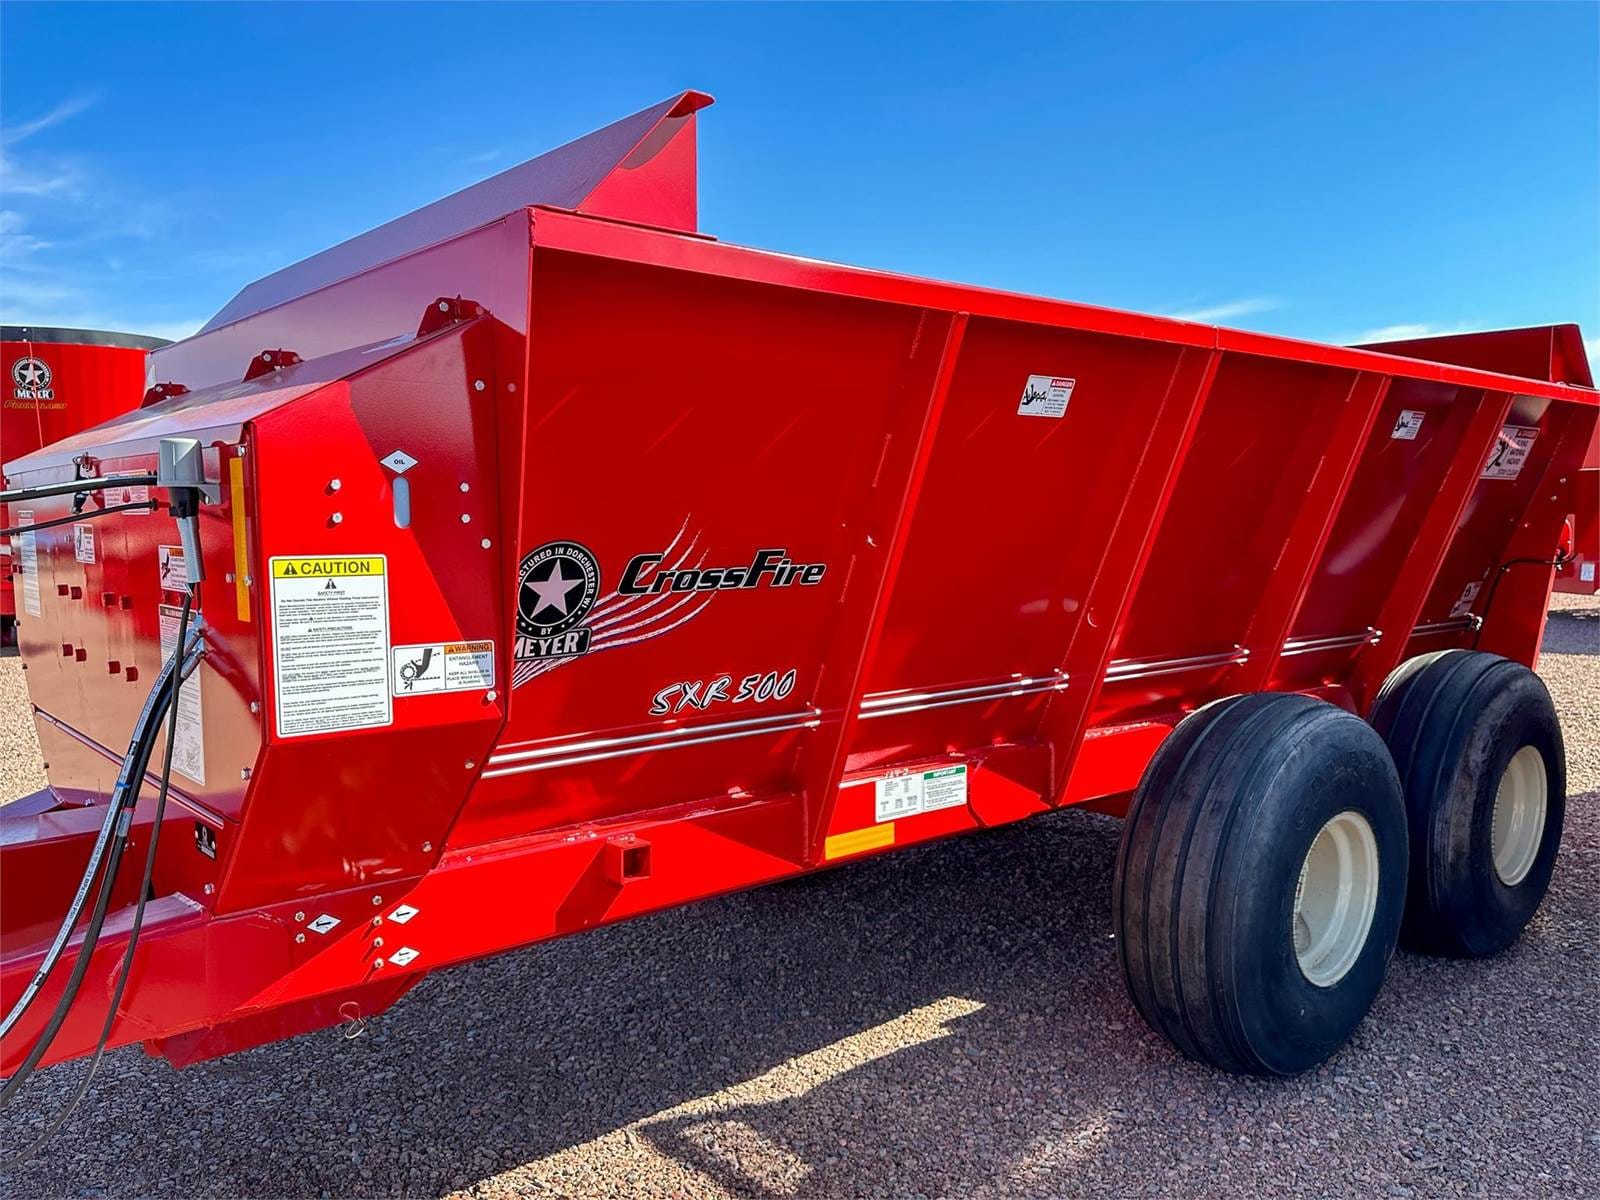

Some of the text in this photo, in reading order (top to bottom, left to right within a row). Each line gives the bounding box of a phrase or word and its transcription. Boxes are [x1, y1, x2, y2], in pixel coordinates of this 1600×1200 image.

[17, 389, 50, 399] MEYER
[300, 561, 370, 575] CAUTION
[555, 547, 564, 555] IN
[566, 548, 596, 595] DORCHESTER
[618, 549, 826, 596] CrossFire
[541, 627, 552, 635] BY
[649, 669, 797, 715] SXR 500
